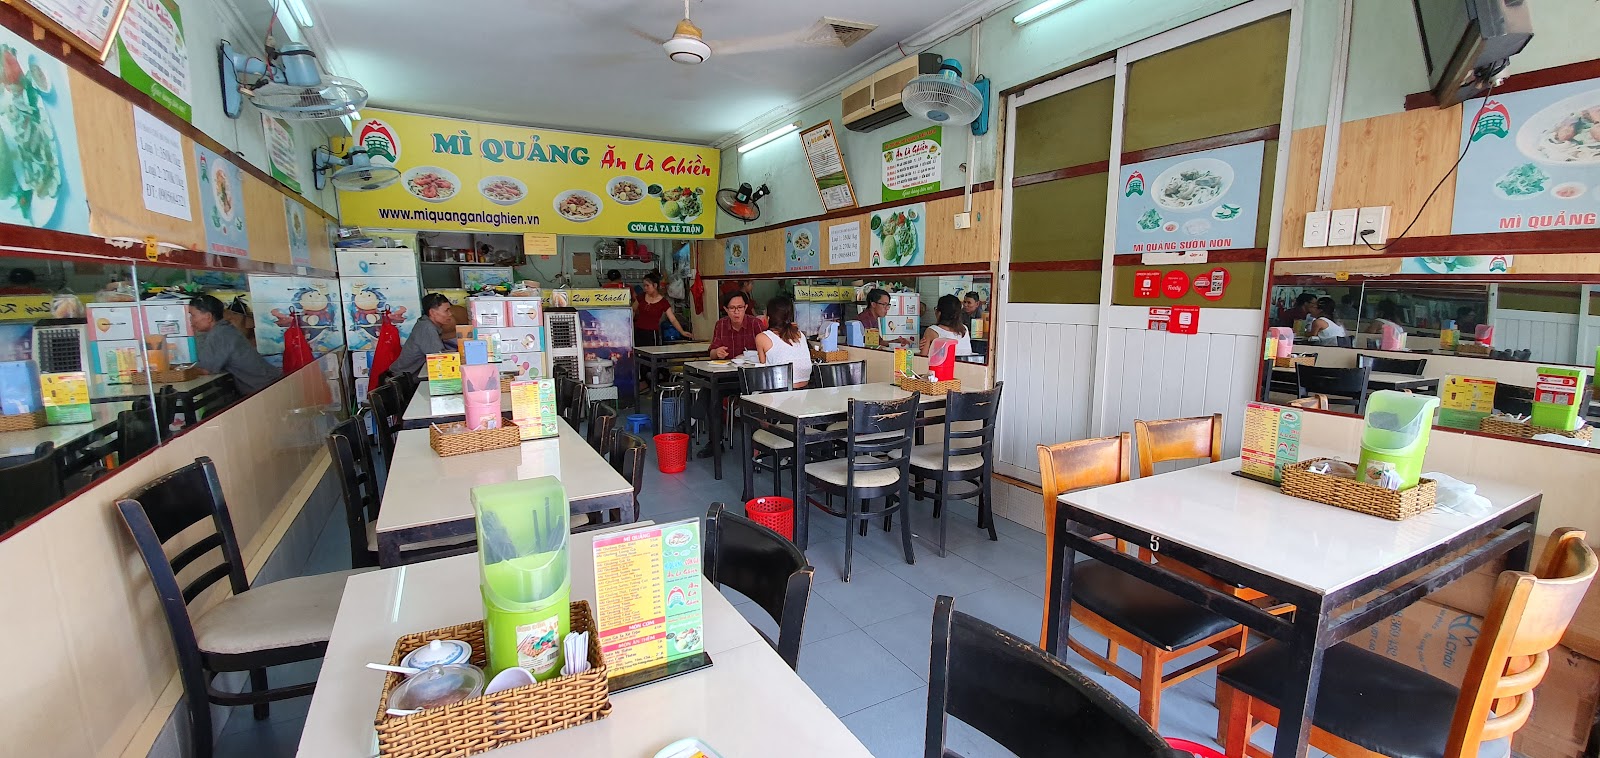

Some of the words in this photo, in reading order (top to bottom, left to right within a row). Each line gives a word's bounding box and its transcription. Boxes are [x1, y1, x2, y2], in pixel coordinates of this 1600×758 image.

[431, 130, 473, 156] MÌ
[480, 134, 590, 166] QUẢNG
[600, 144, 626, 170] Ăn
[634, 153, 654, 172] Là
[661, 154, 711, 176] Ghiền
[378, 208, 540, 226] www.miquanganlaghien.vn
[1500, 214, 1522, 228] MÌ
[1528, 210, 1596, 229] QUẢNG
[660, 224, 670, 232] TA
[1210, 238, 1232, 248] NON
[572, 294, 590, 303] Quý
[594, 292, 626, 302] Khách!
[1150, 534, 1160, 551] 5
